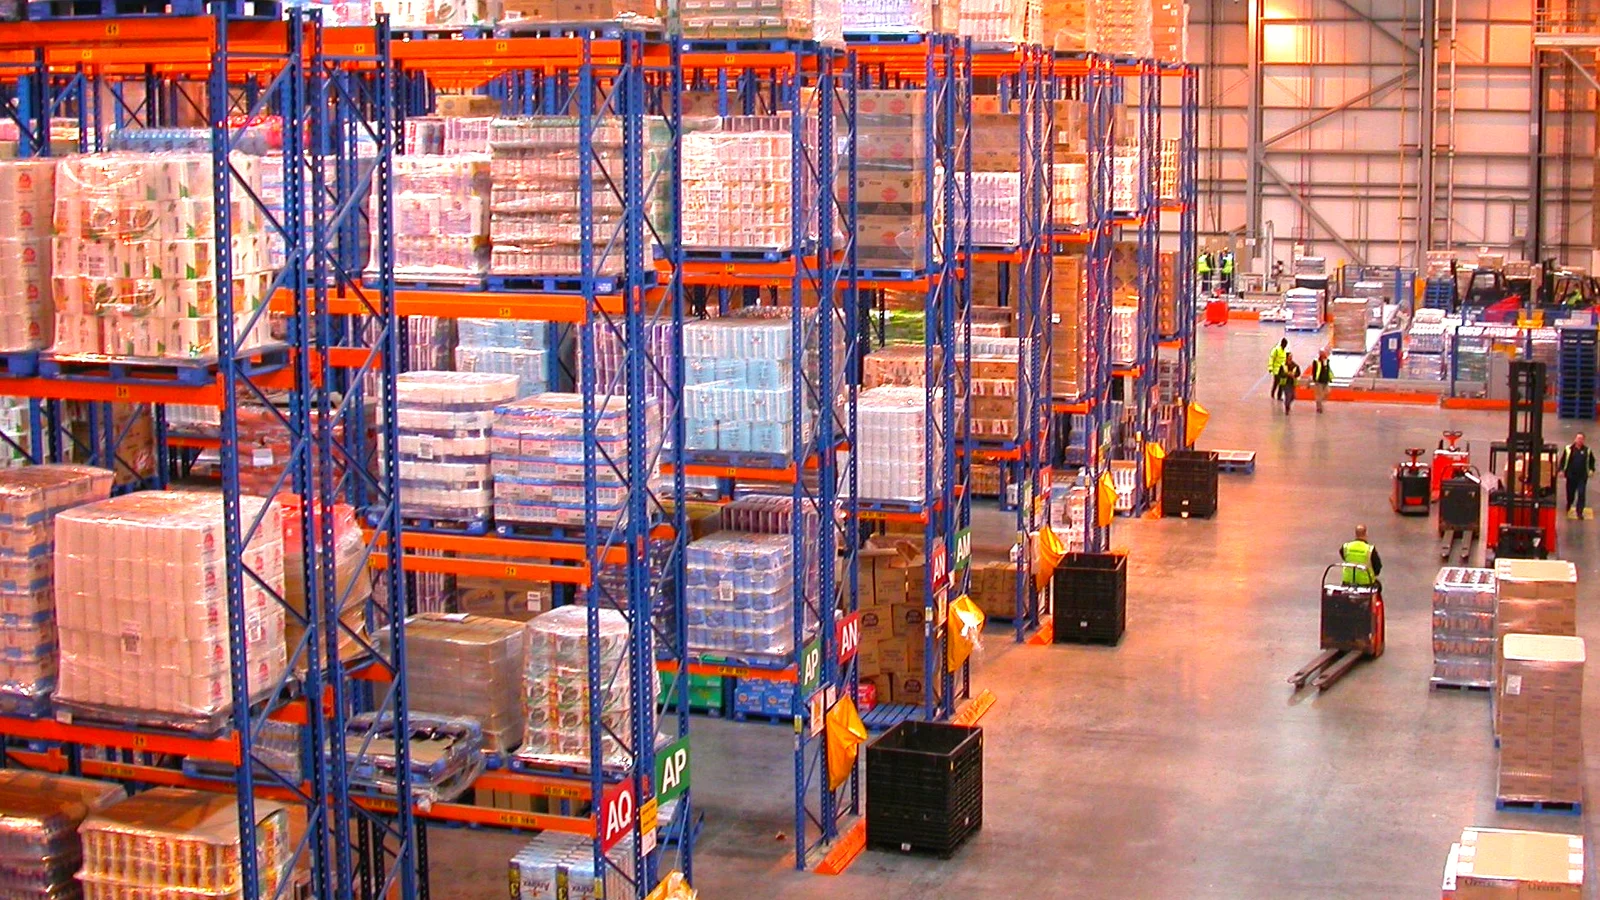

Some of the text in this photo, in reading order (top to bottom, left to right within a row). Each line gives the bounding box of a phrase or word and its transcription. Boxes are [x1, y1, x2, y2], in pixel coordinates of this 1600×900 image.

[933, 551, 945, 583] AN
[841, 618, 858, 656] AN
[804, 648, 819, 686] AP
[661, 748, 687, 794] AP
[606, 790, 632, 841] AQ
